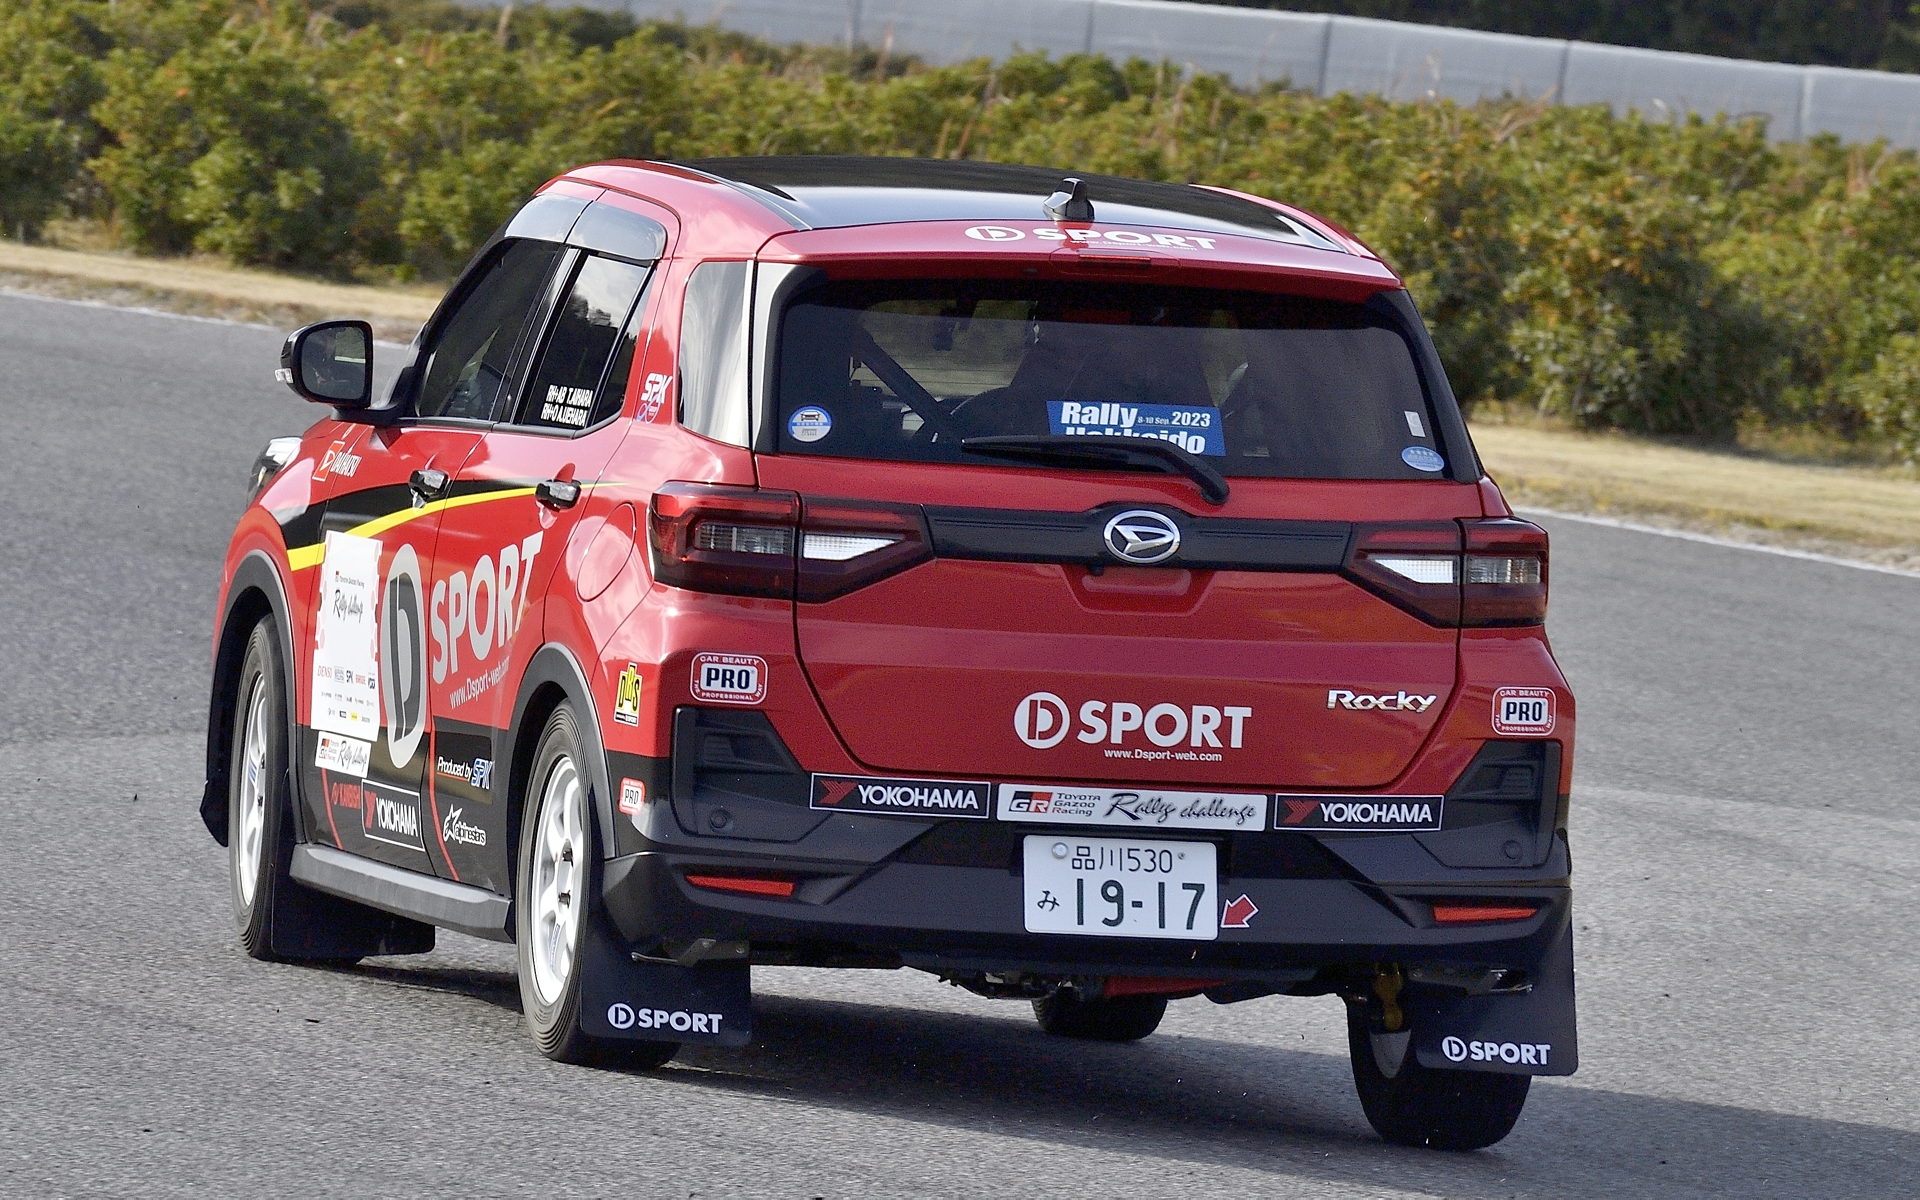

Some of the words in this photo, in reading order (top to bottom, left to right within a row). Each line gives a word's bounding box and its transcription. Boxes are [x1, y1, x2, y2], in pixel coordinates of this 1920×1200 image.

[1032, 228, 1216, 249] SPORT
[641, 373, 673, 404] SPK
[1060, 402, 1138, 428] Rally
[1138, 416, 1153, 425] 8-10
[1171, 411, 1211, 427] 2023
[431, 530, 544, 685] SPORT
[700, 655, 719, 663] CAR
[722, 656, 760, 666] BEAUTY
[706, 667, 750, 690] PRO
[701, 692, 754, 701] PROFESSIONAL
[1327, 689, 1437, 713] Rocky
[1500, 689, 1516, 697] CAR
[1519, 689, 1550, 698] BEAUTY
[1505, 701, 1543, 722] PRO
[1077, 700, 1252, 749] SPORT
[1501, 725, 1545, 733] PROFESSIONAL
[1104, 748, 1222, 762] www.Dsport-web.com
[437, 756, 465, 778] Produced
[464, 762, 473, 782] by
[471, 758, 495, 790] SPK
[624, 788, 639, 805] PRO
[858, 784, 979, 810] YOKOHAMA
[1009, 798, 1050, 813] GR
[1057, 792, 1101, 801] TOYOTA
[1054, 800, 1095, 808] GAZOO
[376, 797, 418, 838] YOKOHAMA
[1052, 806, 1093, 817] Racing
[1103, 792, 1176, 824] Rally
[1179, 797, 1255, 826] challenge
[1320, 802, 1433, 824] YOKOHAMA
[1037, 890, 1060, 912] み
[1076, 878, 1206, 931] 19-17
[638, 1008, 723, 1034] SPORT
[1469, 1040, 1551, 1065] SPORT
